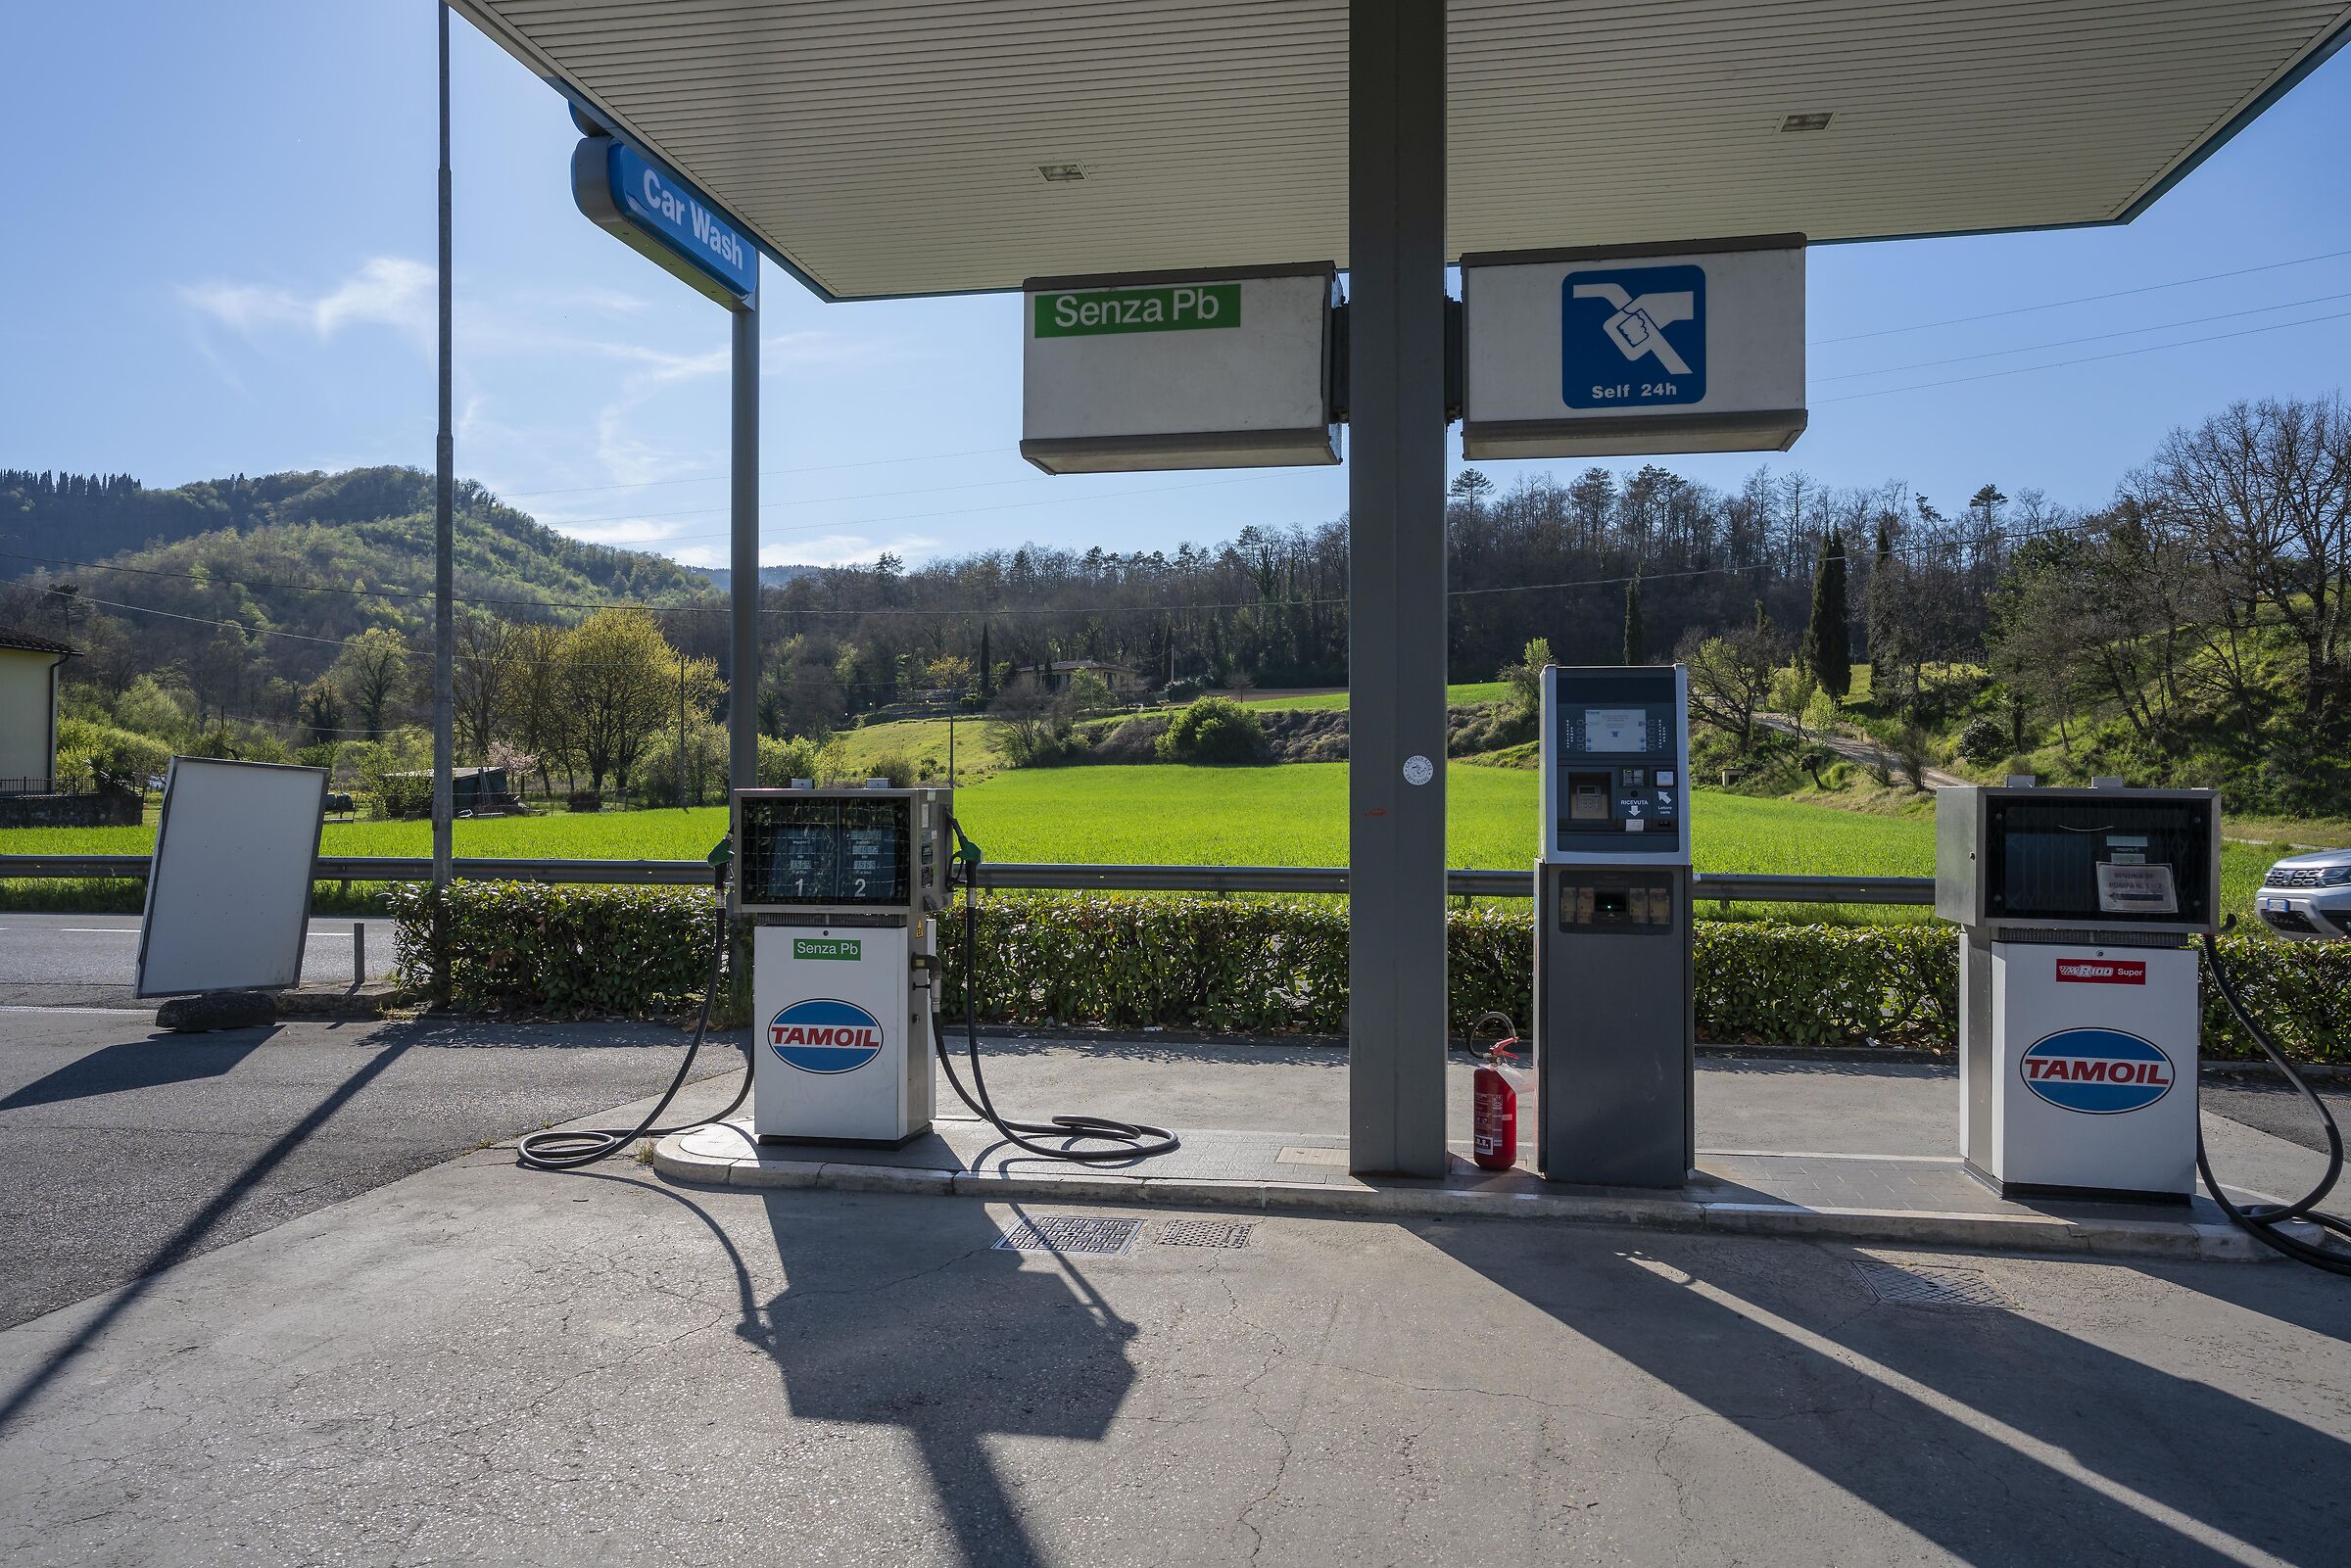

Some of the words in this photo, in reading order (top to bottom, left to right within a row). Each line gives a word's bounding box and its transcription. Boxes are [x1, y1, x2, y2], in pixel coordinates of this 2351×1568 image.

[644, 168, 686, 226] Car
[690, 200, 744, 270] Wash
[1054, 295, 1164, 328] Senza
[1174, 289, 1220, 320] Pb
[1592, 384, 1631, 400] Self
[1641, 382, 1677, 397] 24h
[795, 878, 804, 897] 1
[854, 878, 866, 897] 2
[796, 942, 837, 954] Senza
[840, 942, 858, 955] Pb
[2117, 968, 2143, 977] Super
[771, 1026, 880, 1048] TAMOIL
[2024, 1058, 2169, 1085] TAMOIL
